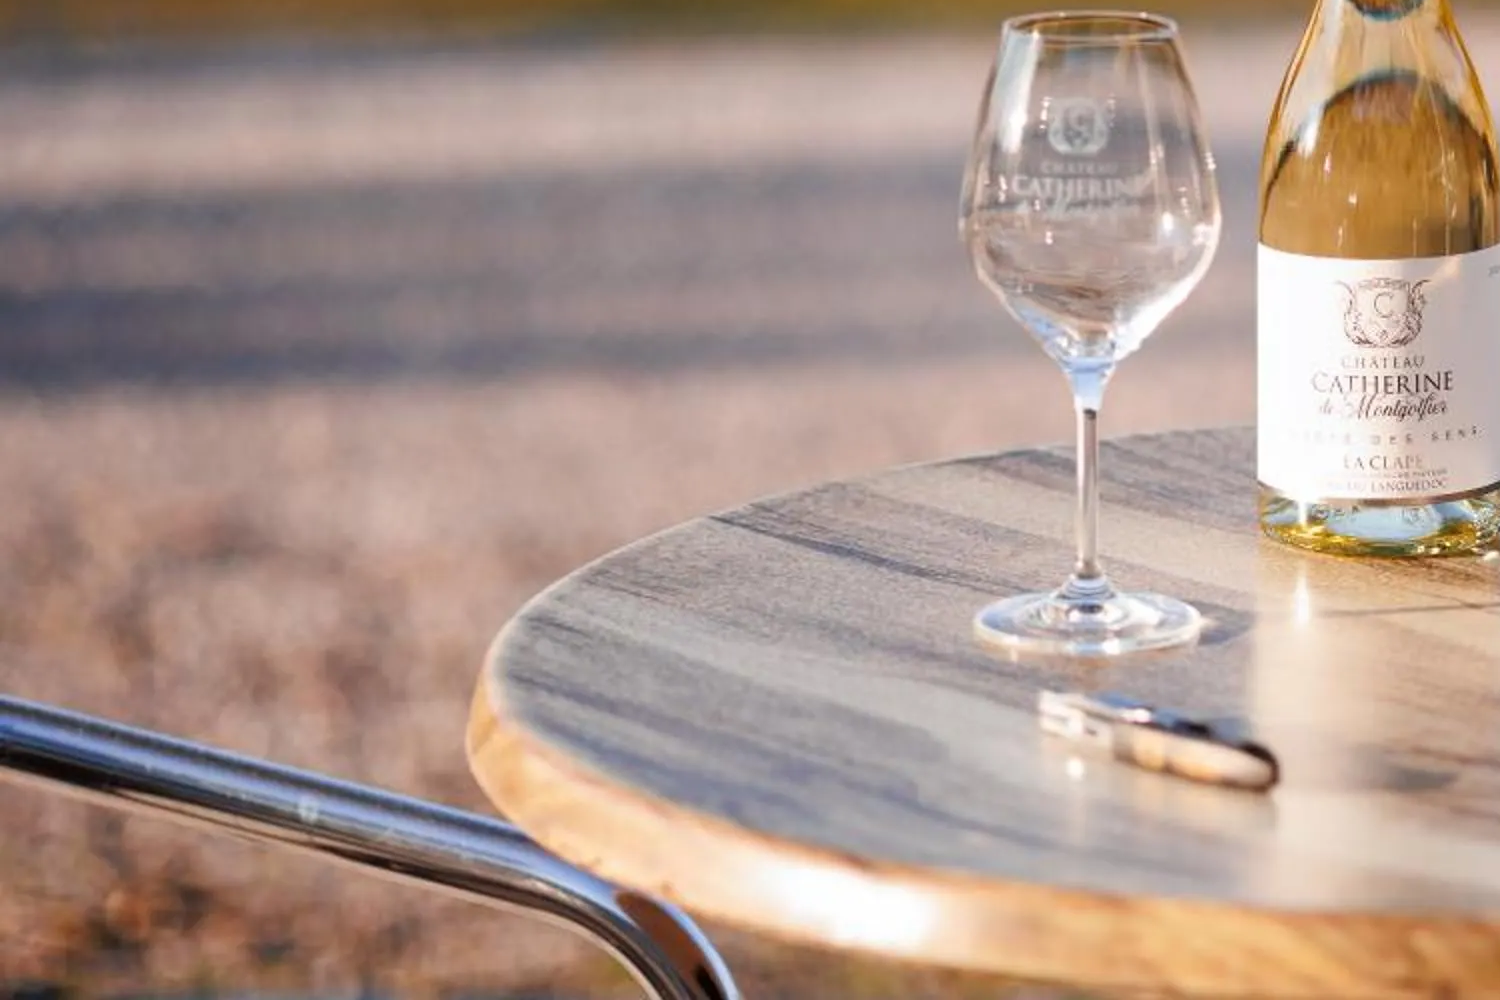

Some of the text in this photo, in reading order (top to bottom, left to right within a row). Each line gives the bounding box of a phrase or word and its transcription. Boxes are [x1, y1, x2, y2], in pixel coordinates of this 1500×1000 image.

[1311, 370, 1454, 395] CATHERINE
[1369, 455, 1424, 471] CLAPE
[1371, 478, 1449, 493] LANGUEDOC
